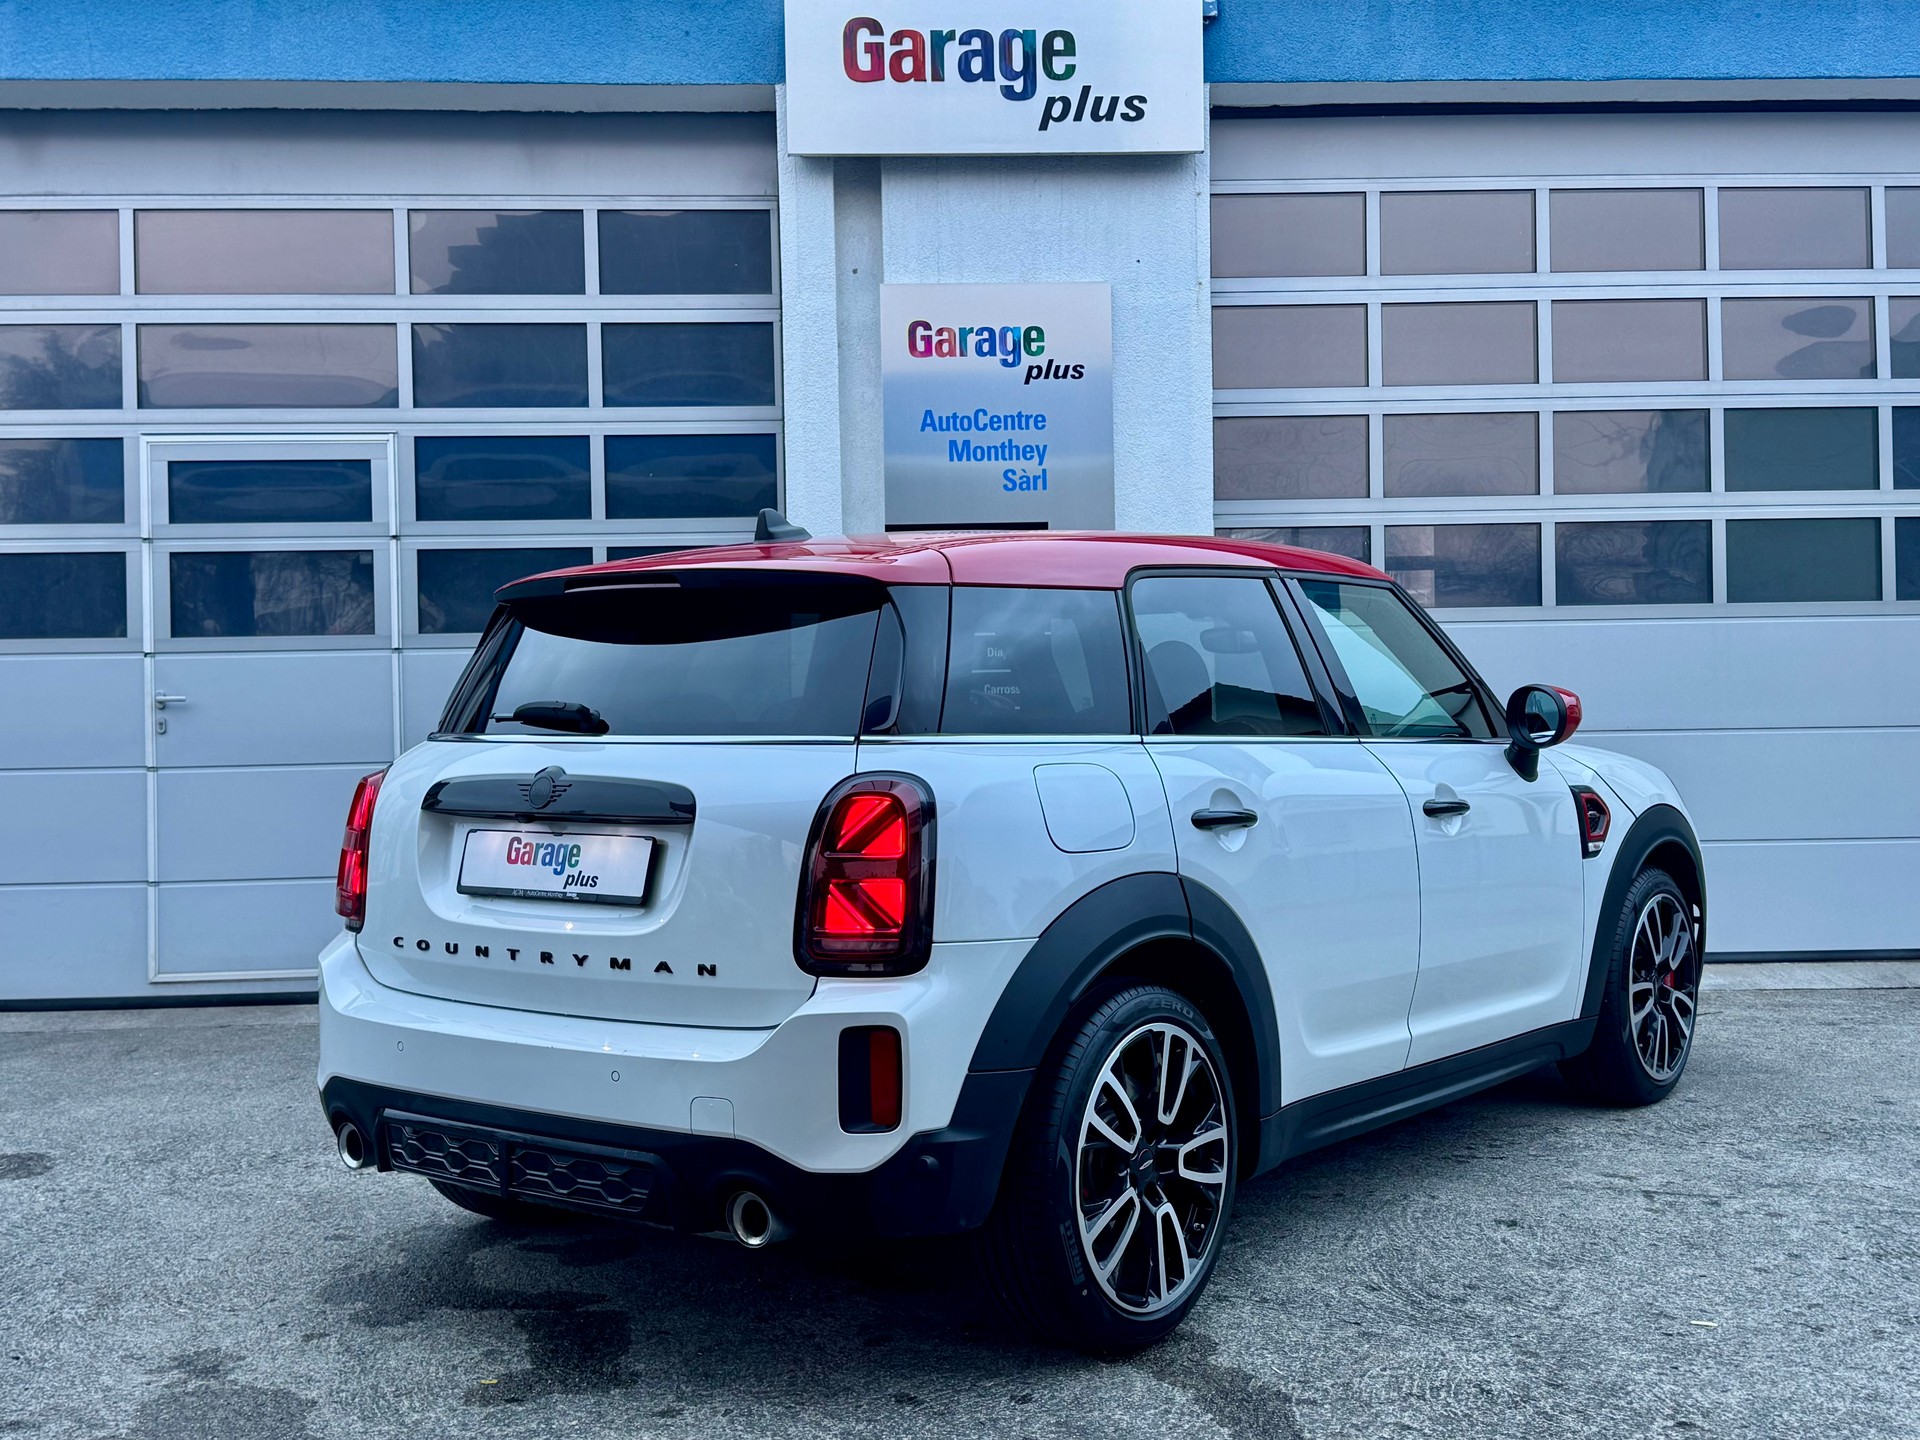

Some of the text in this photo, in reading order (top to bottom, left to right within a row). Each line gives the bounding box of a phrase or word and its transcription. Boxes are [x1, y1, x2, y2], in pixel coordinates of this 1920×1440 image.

[842, 16, 1077, 101] Garage
[1038, 85, 1148, 131] plus
[907, 320, 1045, 368] Garage
[1023, 359, 1085, 385] plus
[920, 409, 1046, 432] AutoCentre
[948, 439, 1048, 466] Monthey
[1002, 468, 1048, 492] Sàrl
[987, 647, 1005, 659] Dia
[507, 837, 581, 876] Garage
[563, 870, 599, 889] plus
[392, 935, 718, 977] COUNTRYMAN
